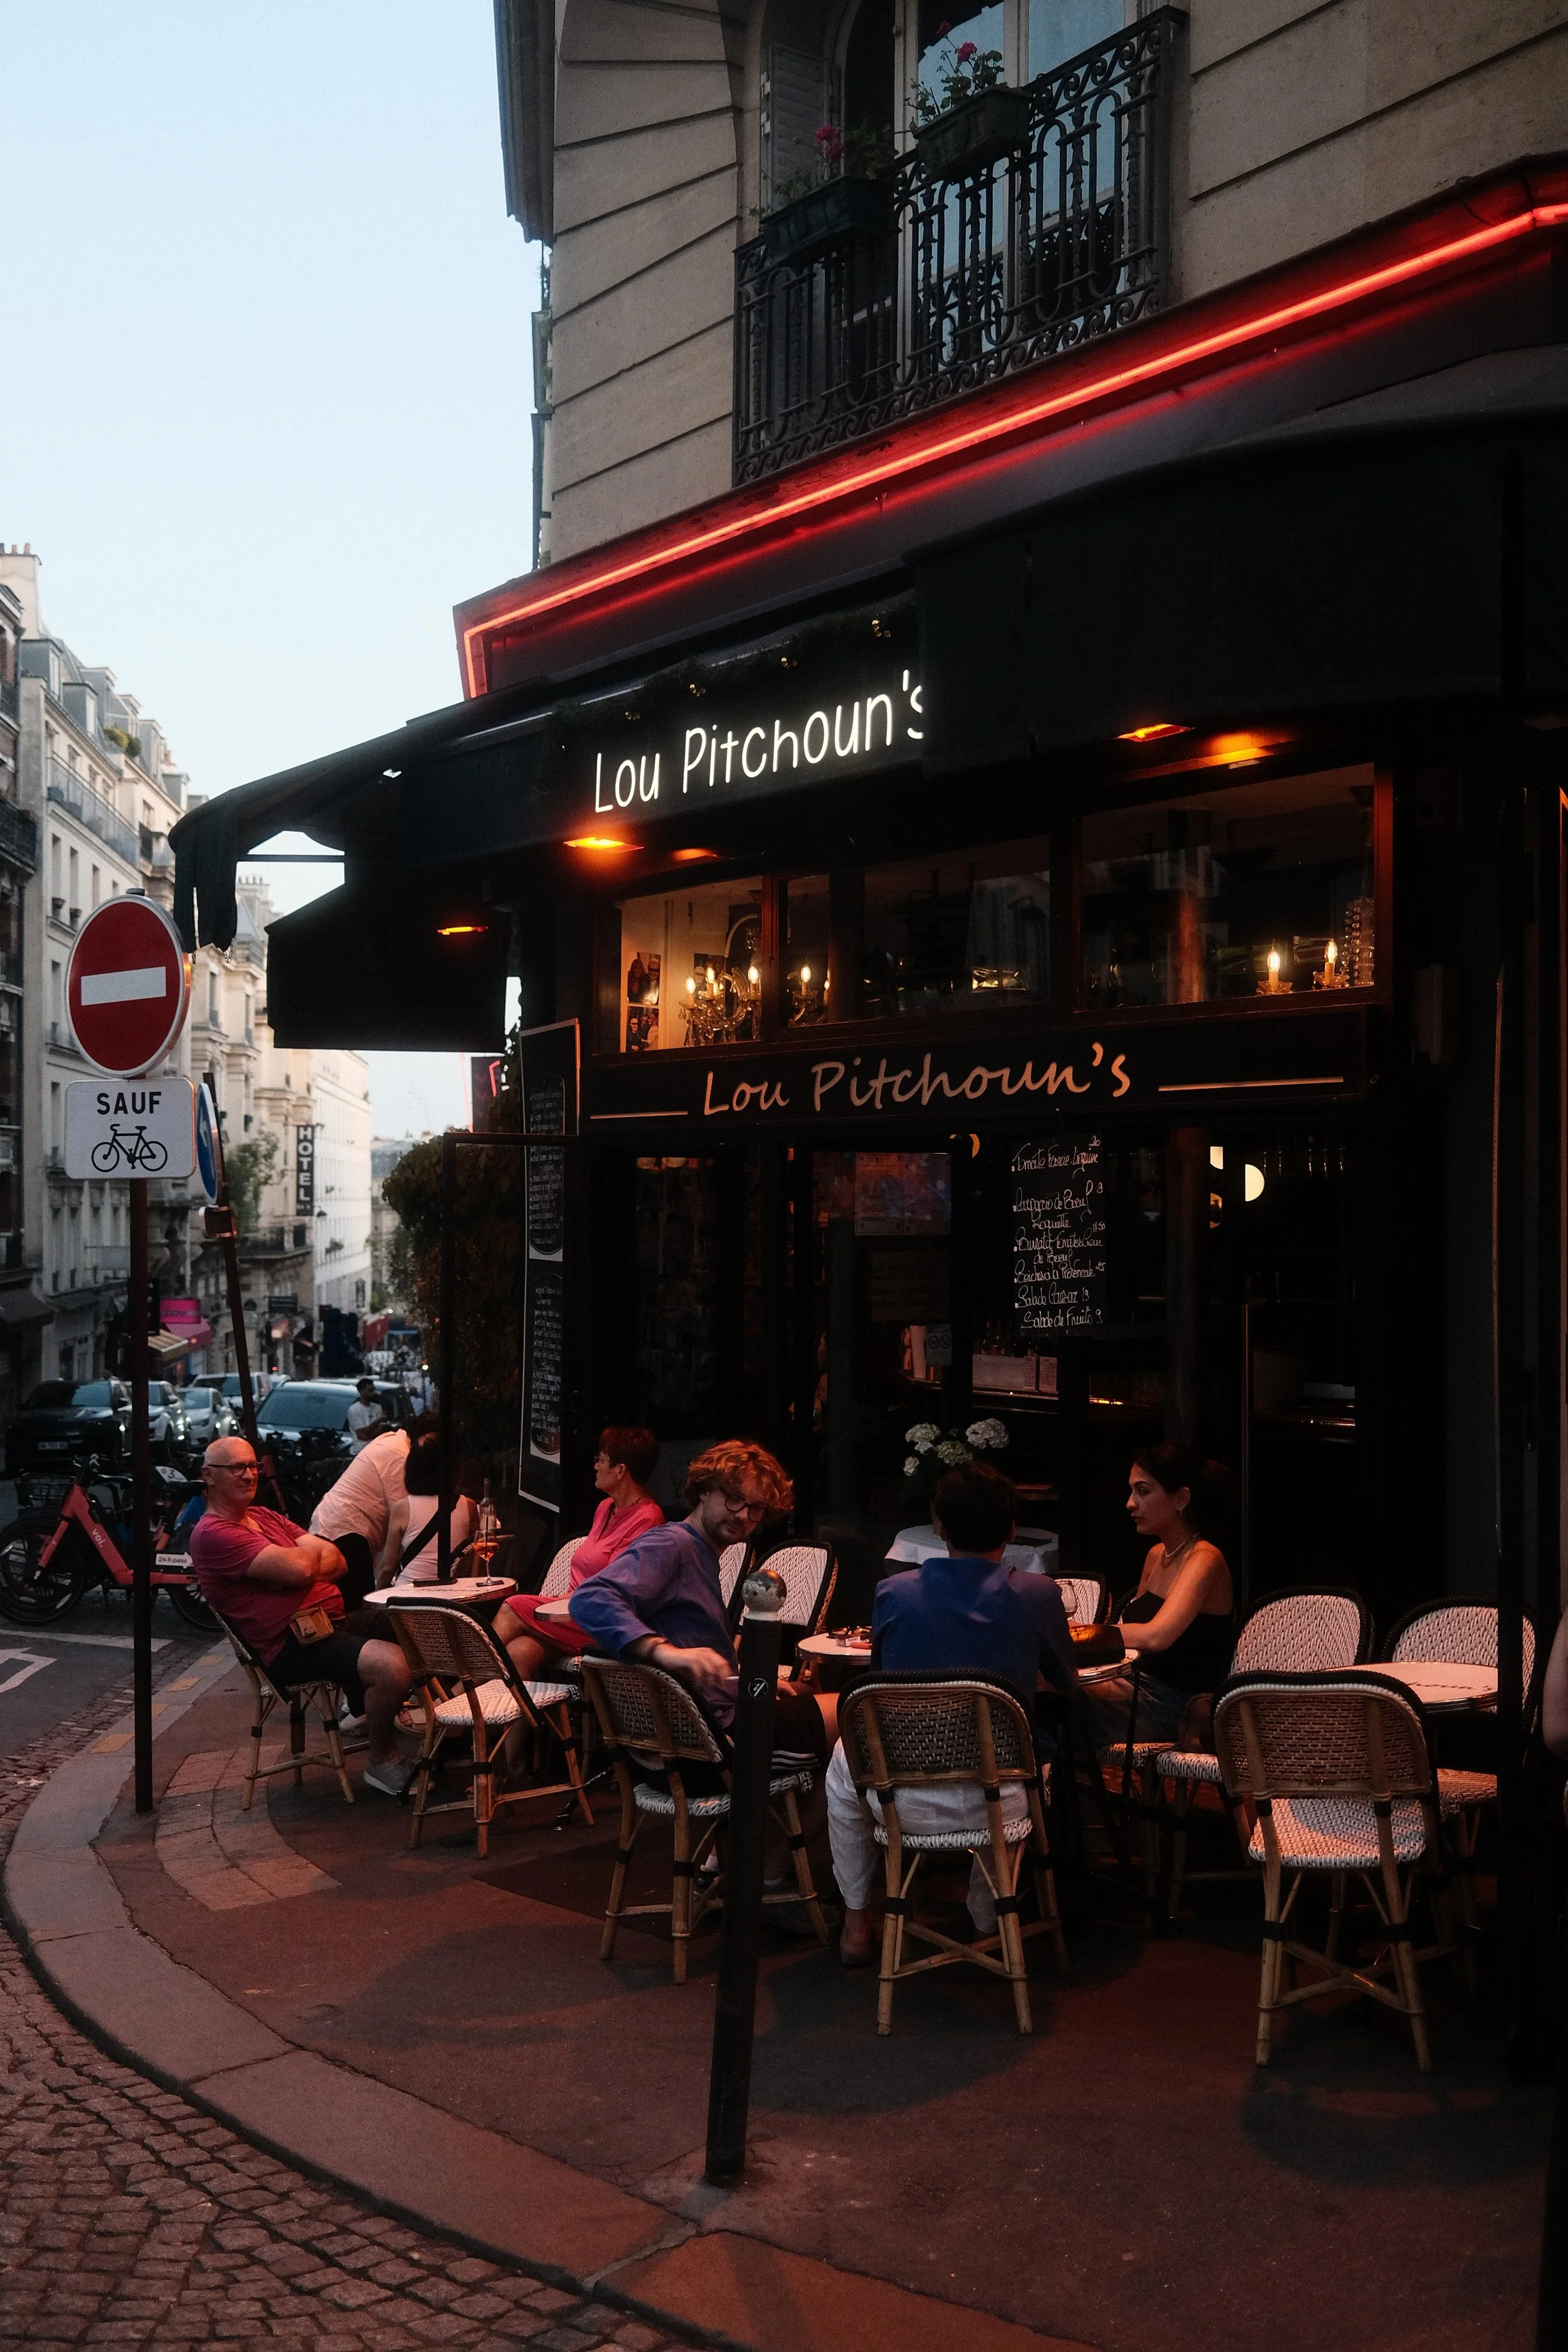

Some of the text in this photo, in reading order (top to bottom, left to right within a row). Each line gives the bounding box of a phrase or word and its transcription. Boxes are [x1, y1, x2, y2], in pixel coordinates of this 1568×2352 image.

[595, 669, 924, 813] Lou Pitchoun's
[97, 1091, 162, 1115] SAUF
[702, 1041, 1131, 1116] Lou Pitchoun's
[298, 1126, 313, 1202] HOTEL
[1088, 1135, 1101, 1147] 20
[1095, 1261, 1106, 1272] 25
